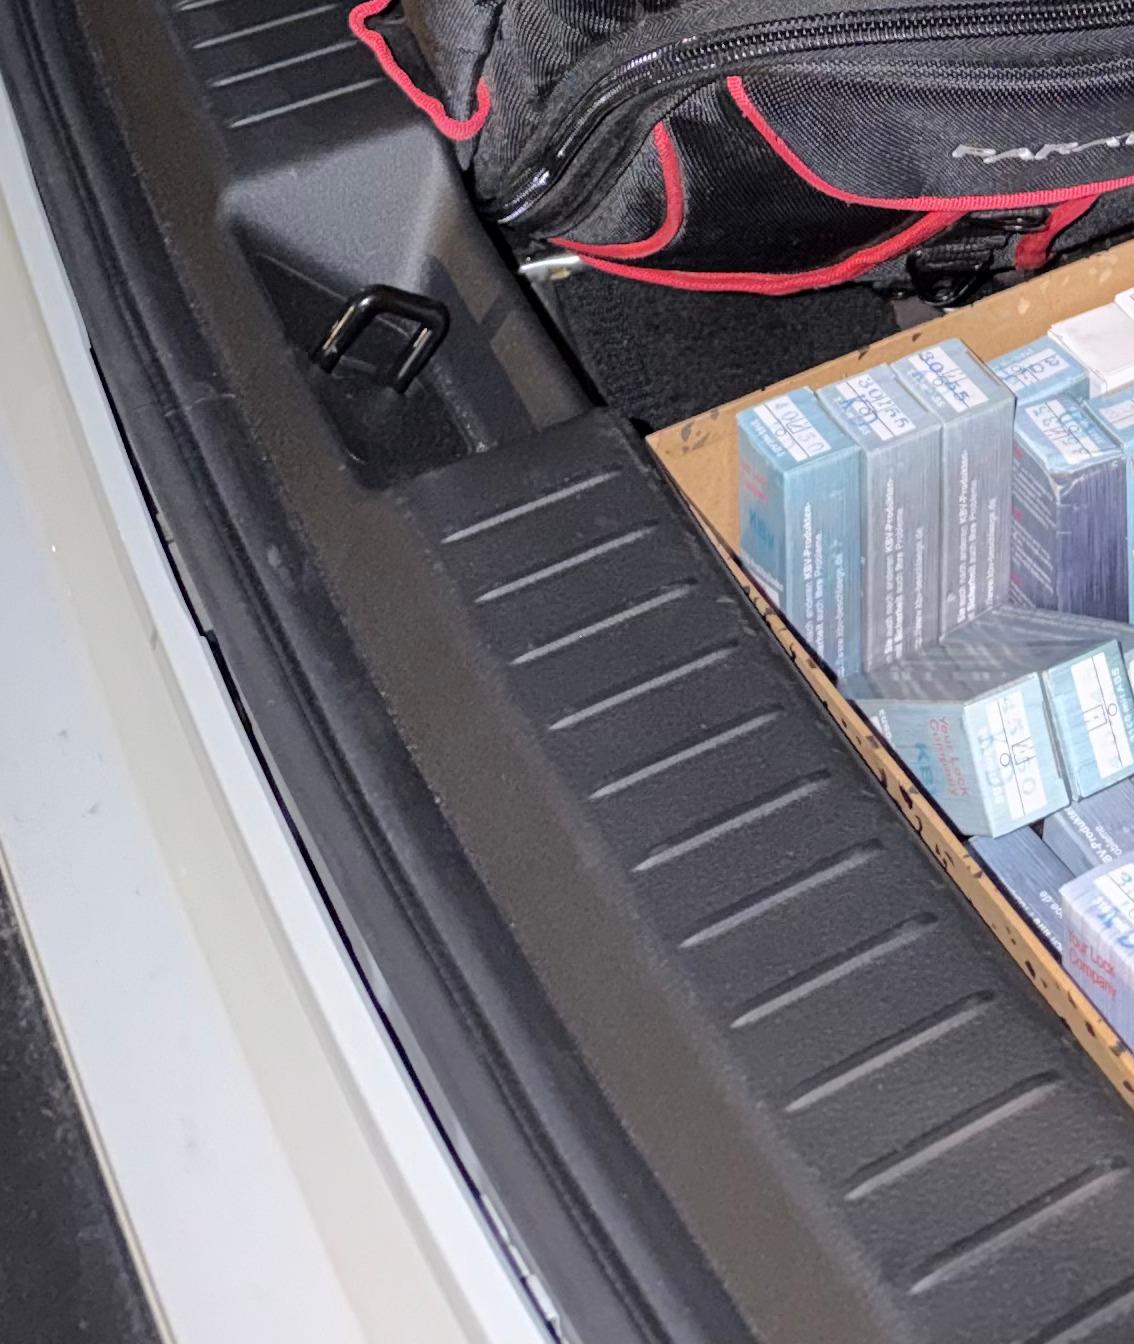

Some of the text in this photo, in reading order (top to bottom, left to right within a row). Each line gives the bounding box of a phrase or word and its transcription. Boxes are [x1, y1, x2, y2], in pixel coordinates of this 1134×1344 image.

[917, 350, 947, 373] 30
[855, 376, 885, 398] 30
[959, 449, 968, 523] KBV-Produkten-
[969, 479, 977, 521] Probleme
[885, 478, 894, 553] KBV-Produkten-
[895, 507, 903, 550] Probleme
[1117, 692, 1130, 713] mit
